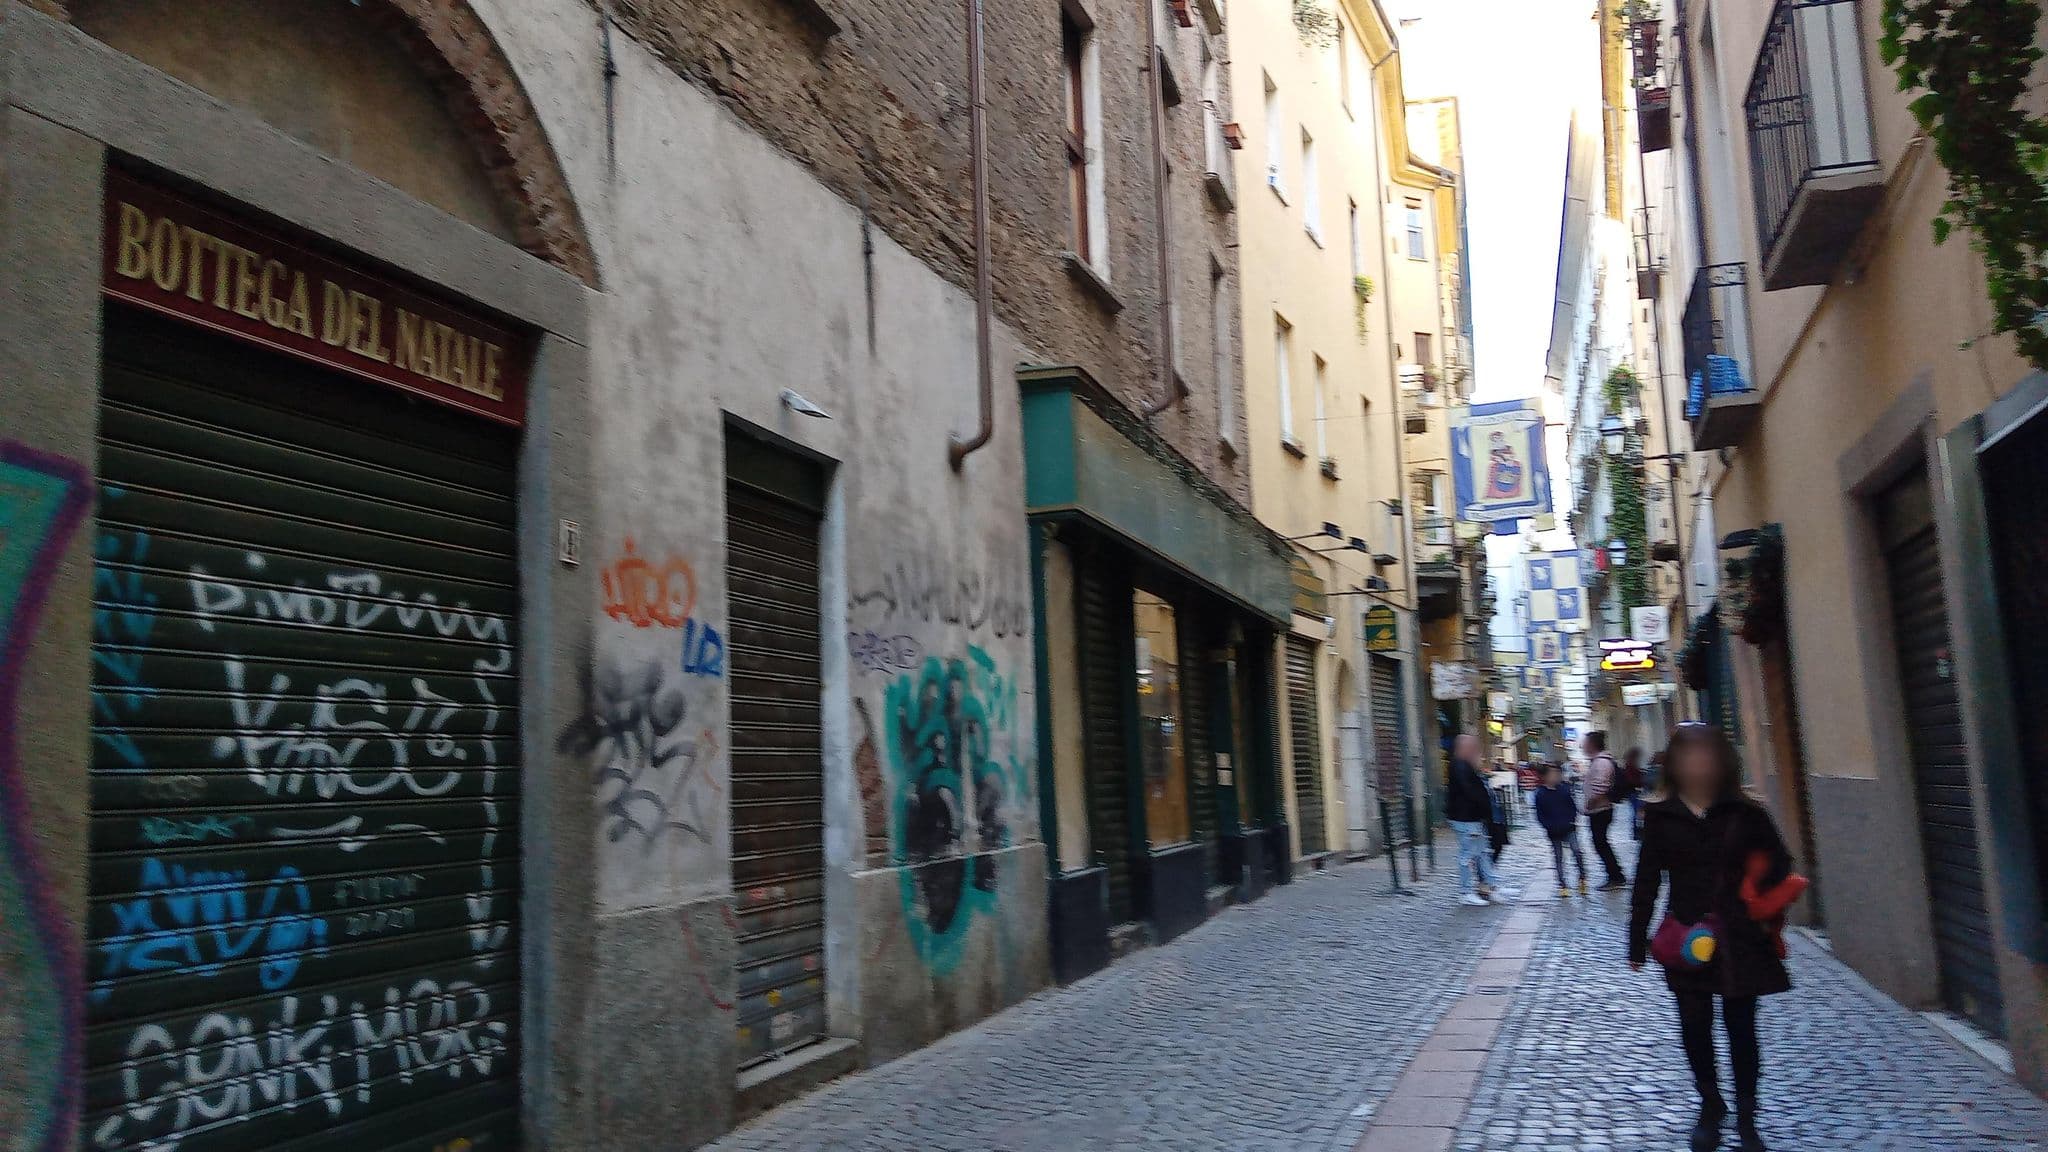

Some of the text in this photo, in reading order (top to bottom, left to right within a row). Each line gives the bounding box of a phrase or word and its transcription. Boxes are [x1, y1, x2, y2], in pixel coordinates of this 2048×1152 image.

[115, 200, 505, 402] BOTTEGA DEL NATALE
